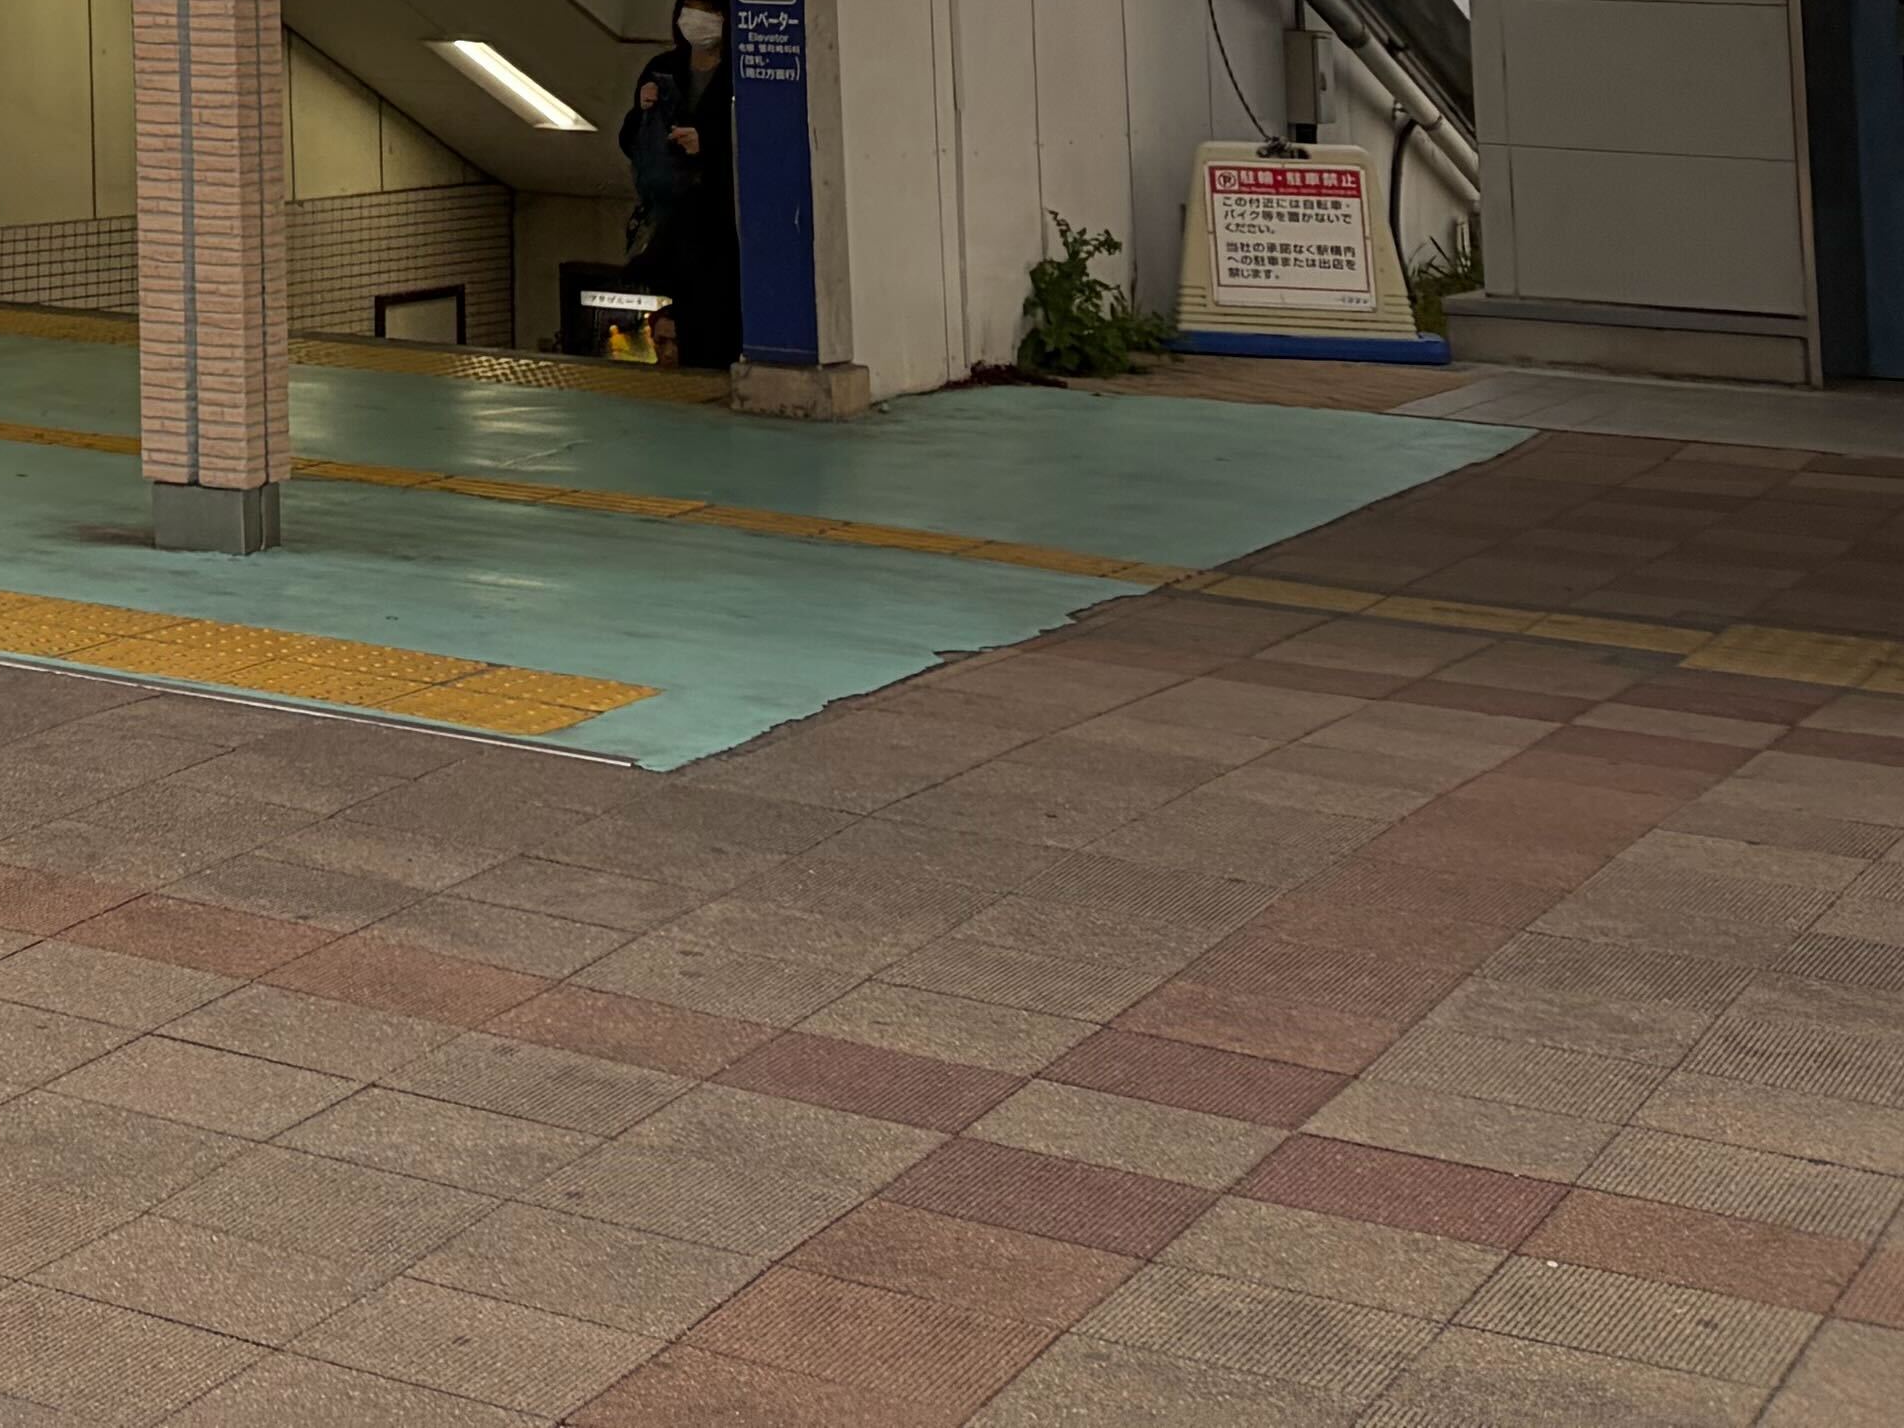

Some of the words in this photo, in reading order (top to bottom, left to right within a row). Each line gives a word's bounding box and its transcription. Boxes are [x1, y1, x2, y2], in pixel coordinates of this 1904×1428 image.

[737, 10, 800, 31] エレベーター
